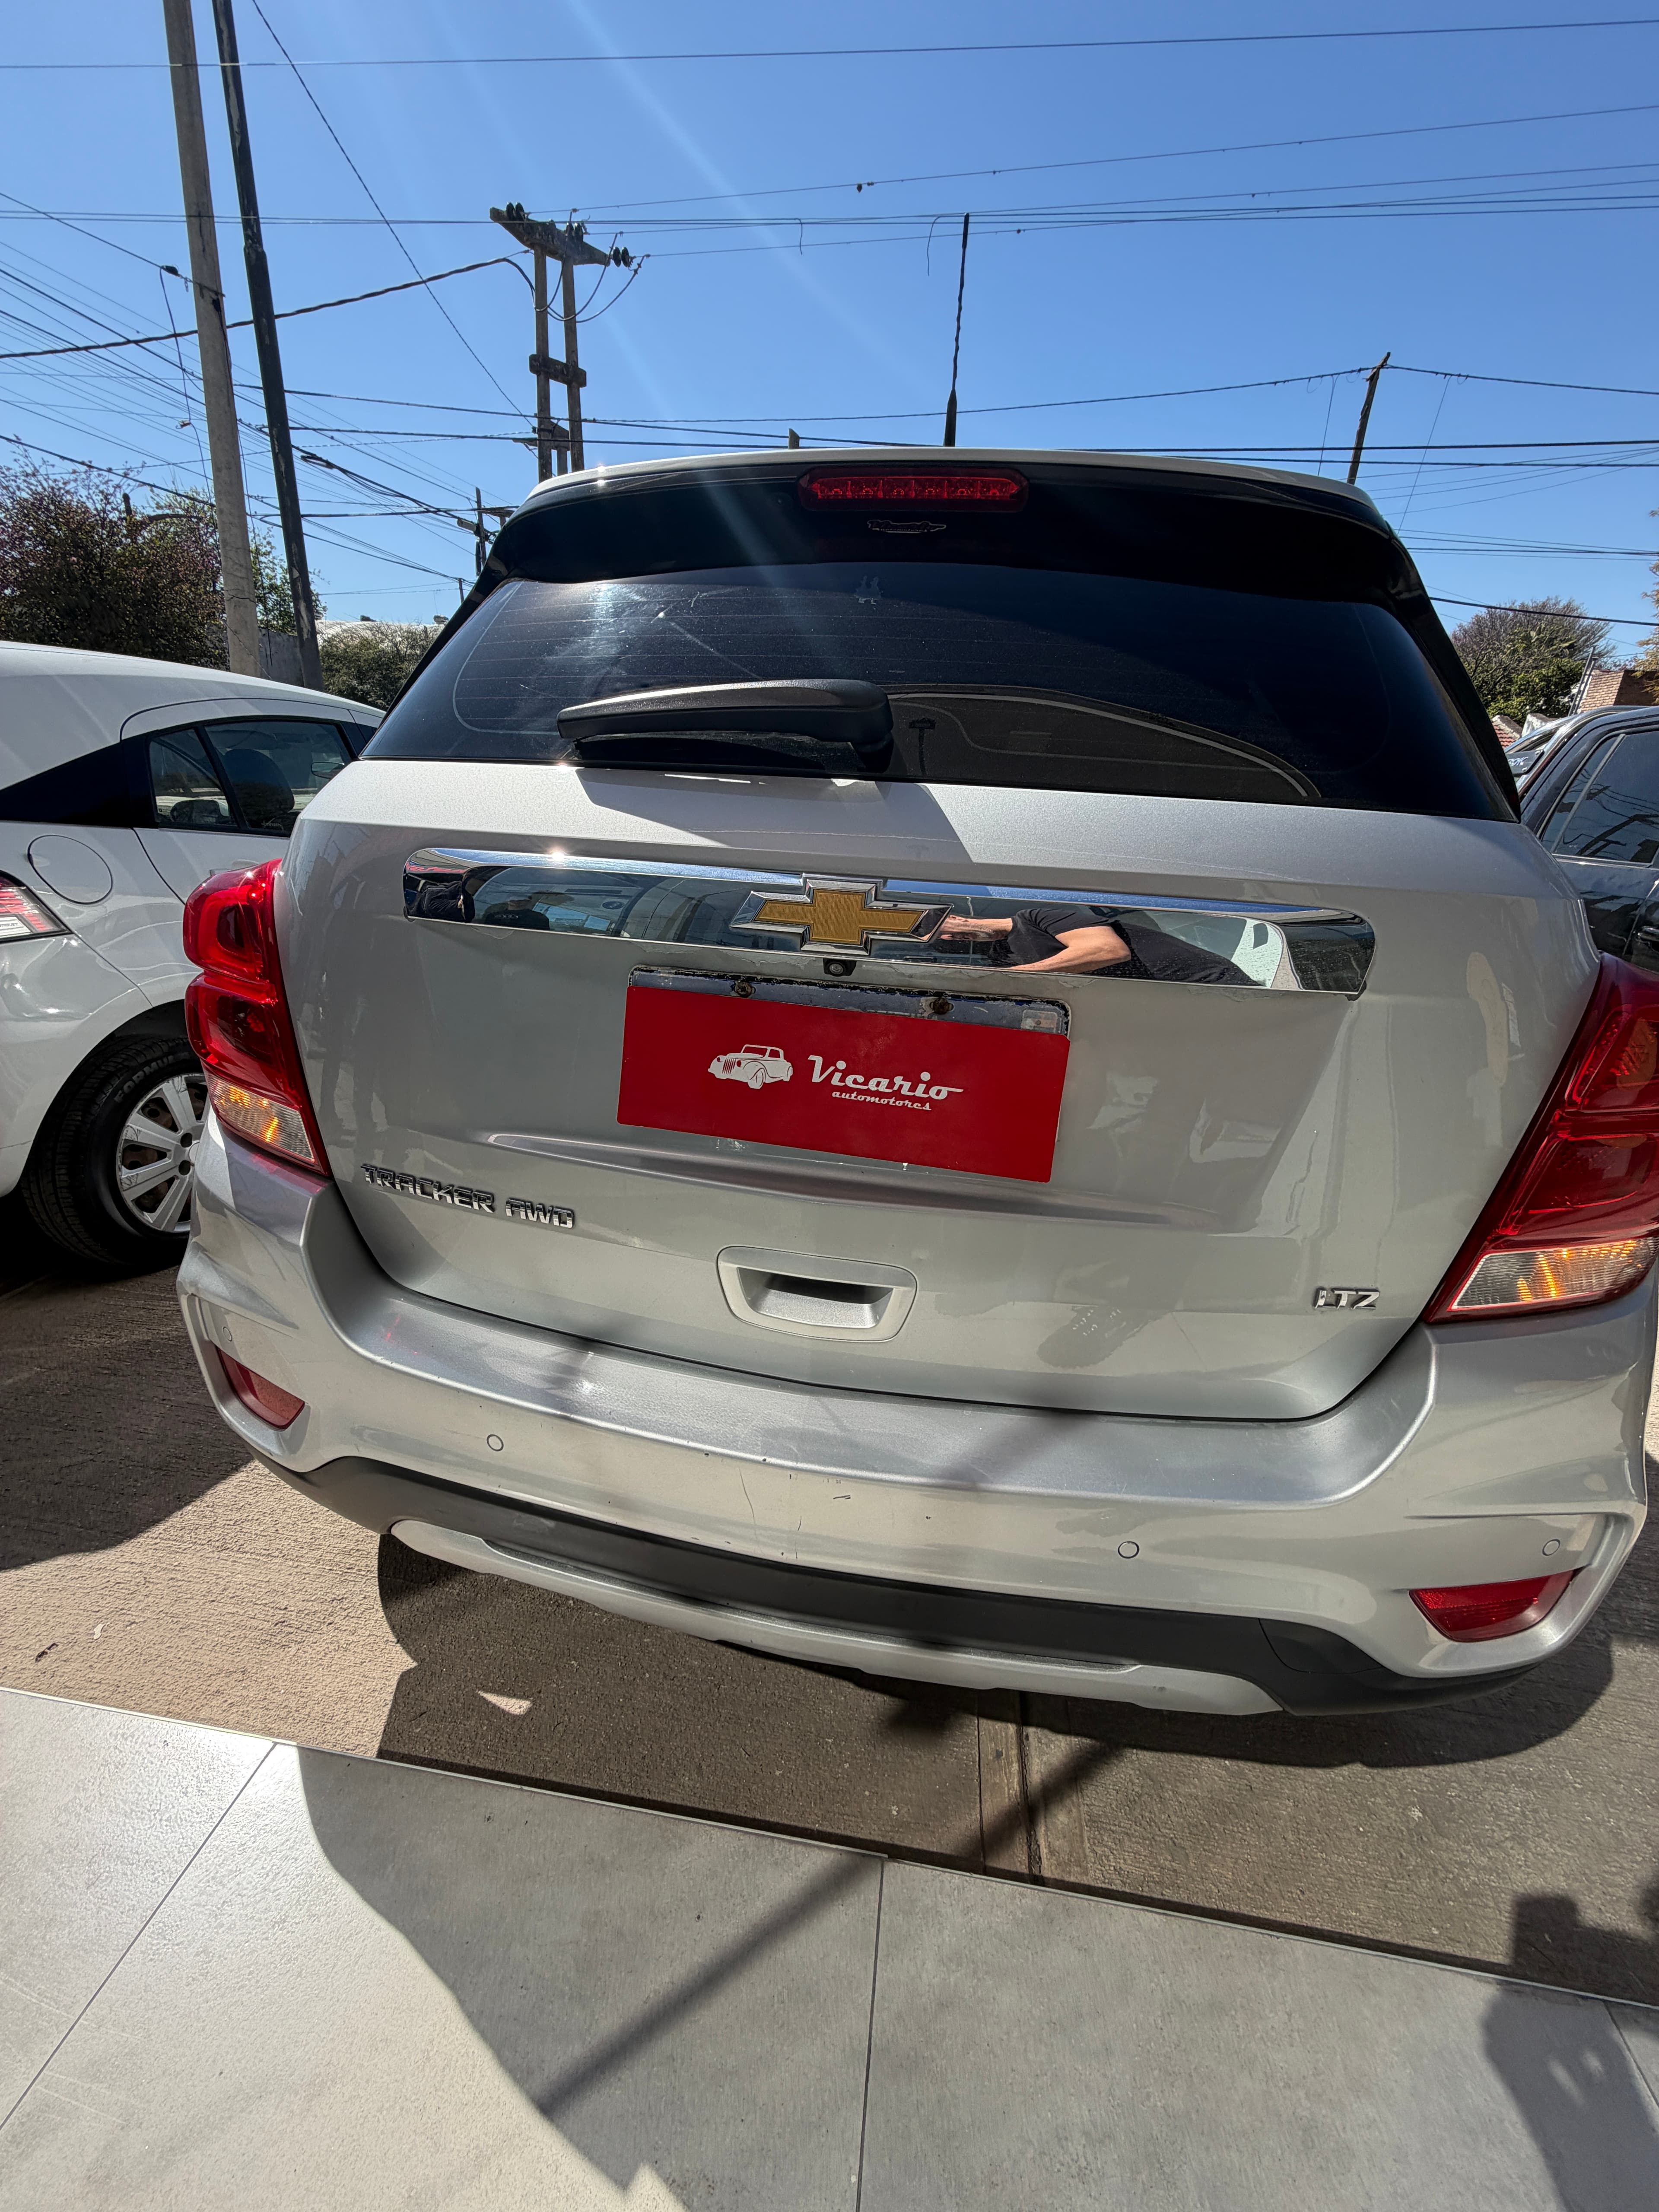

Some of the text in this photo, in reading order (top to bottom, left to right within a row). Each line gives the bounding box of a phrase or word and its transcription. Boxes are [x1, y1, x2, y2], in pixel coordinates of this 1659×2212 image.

[807, 1055, 963, 1100] Vicario
[832, 1091, 932, 1111] automotores
[361, 1163, 575, 1229] TRACKER AWD
[1314, 1287, 1379, 1310] LTZ
